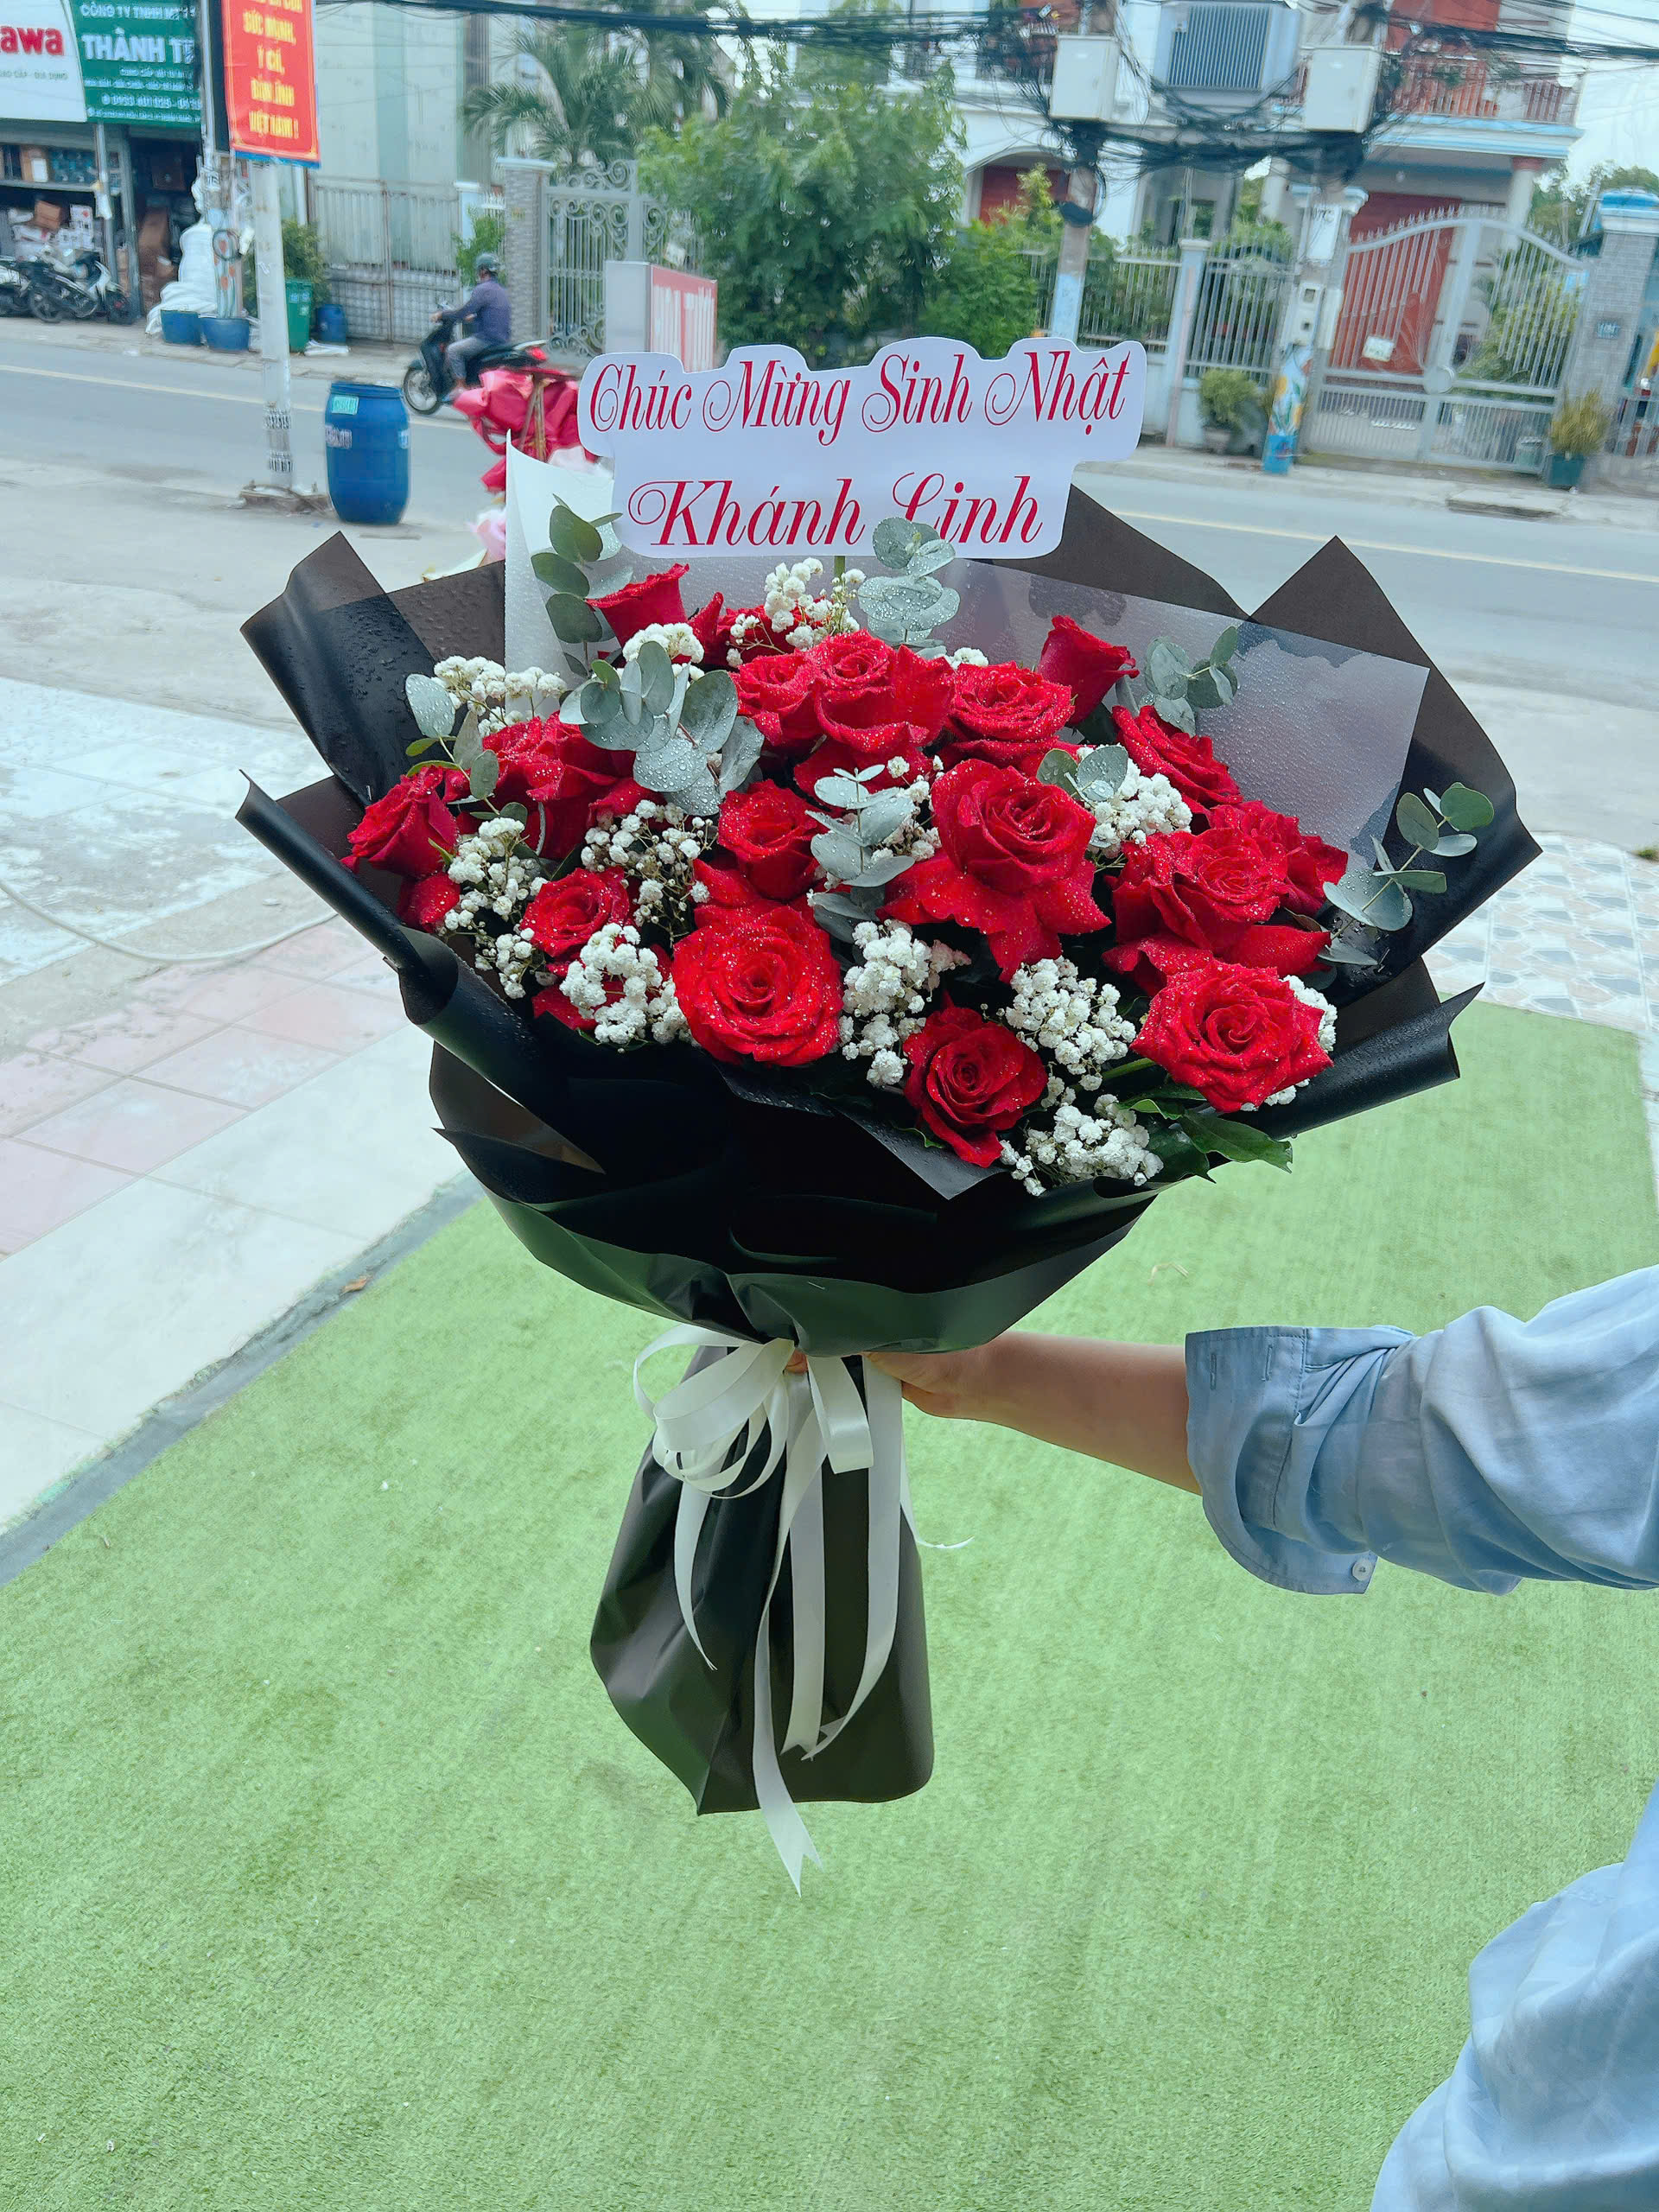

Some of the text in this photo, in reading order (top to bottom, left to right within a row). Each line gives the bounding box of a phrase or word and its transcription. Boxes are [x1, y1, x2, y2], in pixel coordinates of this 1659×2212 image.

[590, 350, 1130, 447] Chúc Mừng Sinh Nhật
[628, 472, 1043, 547] Khánh Linh
